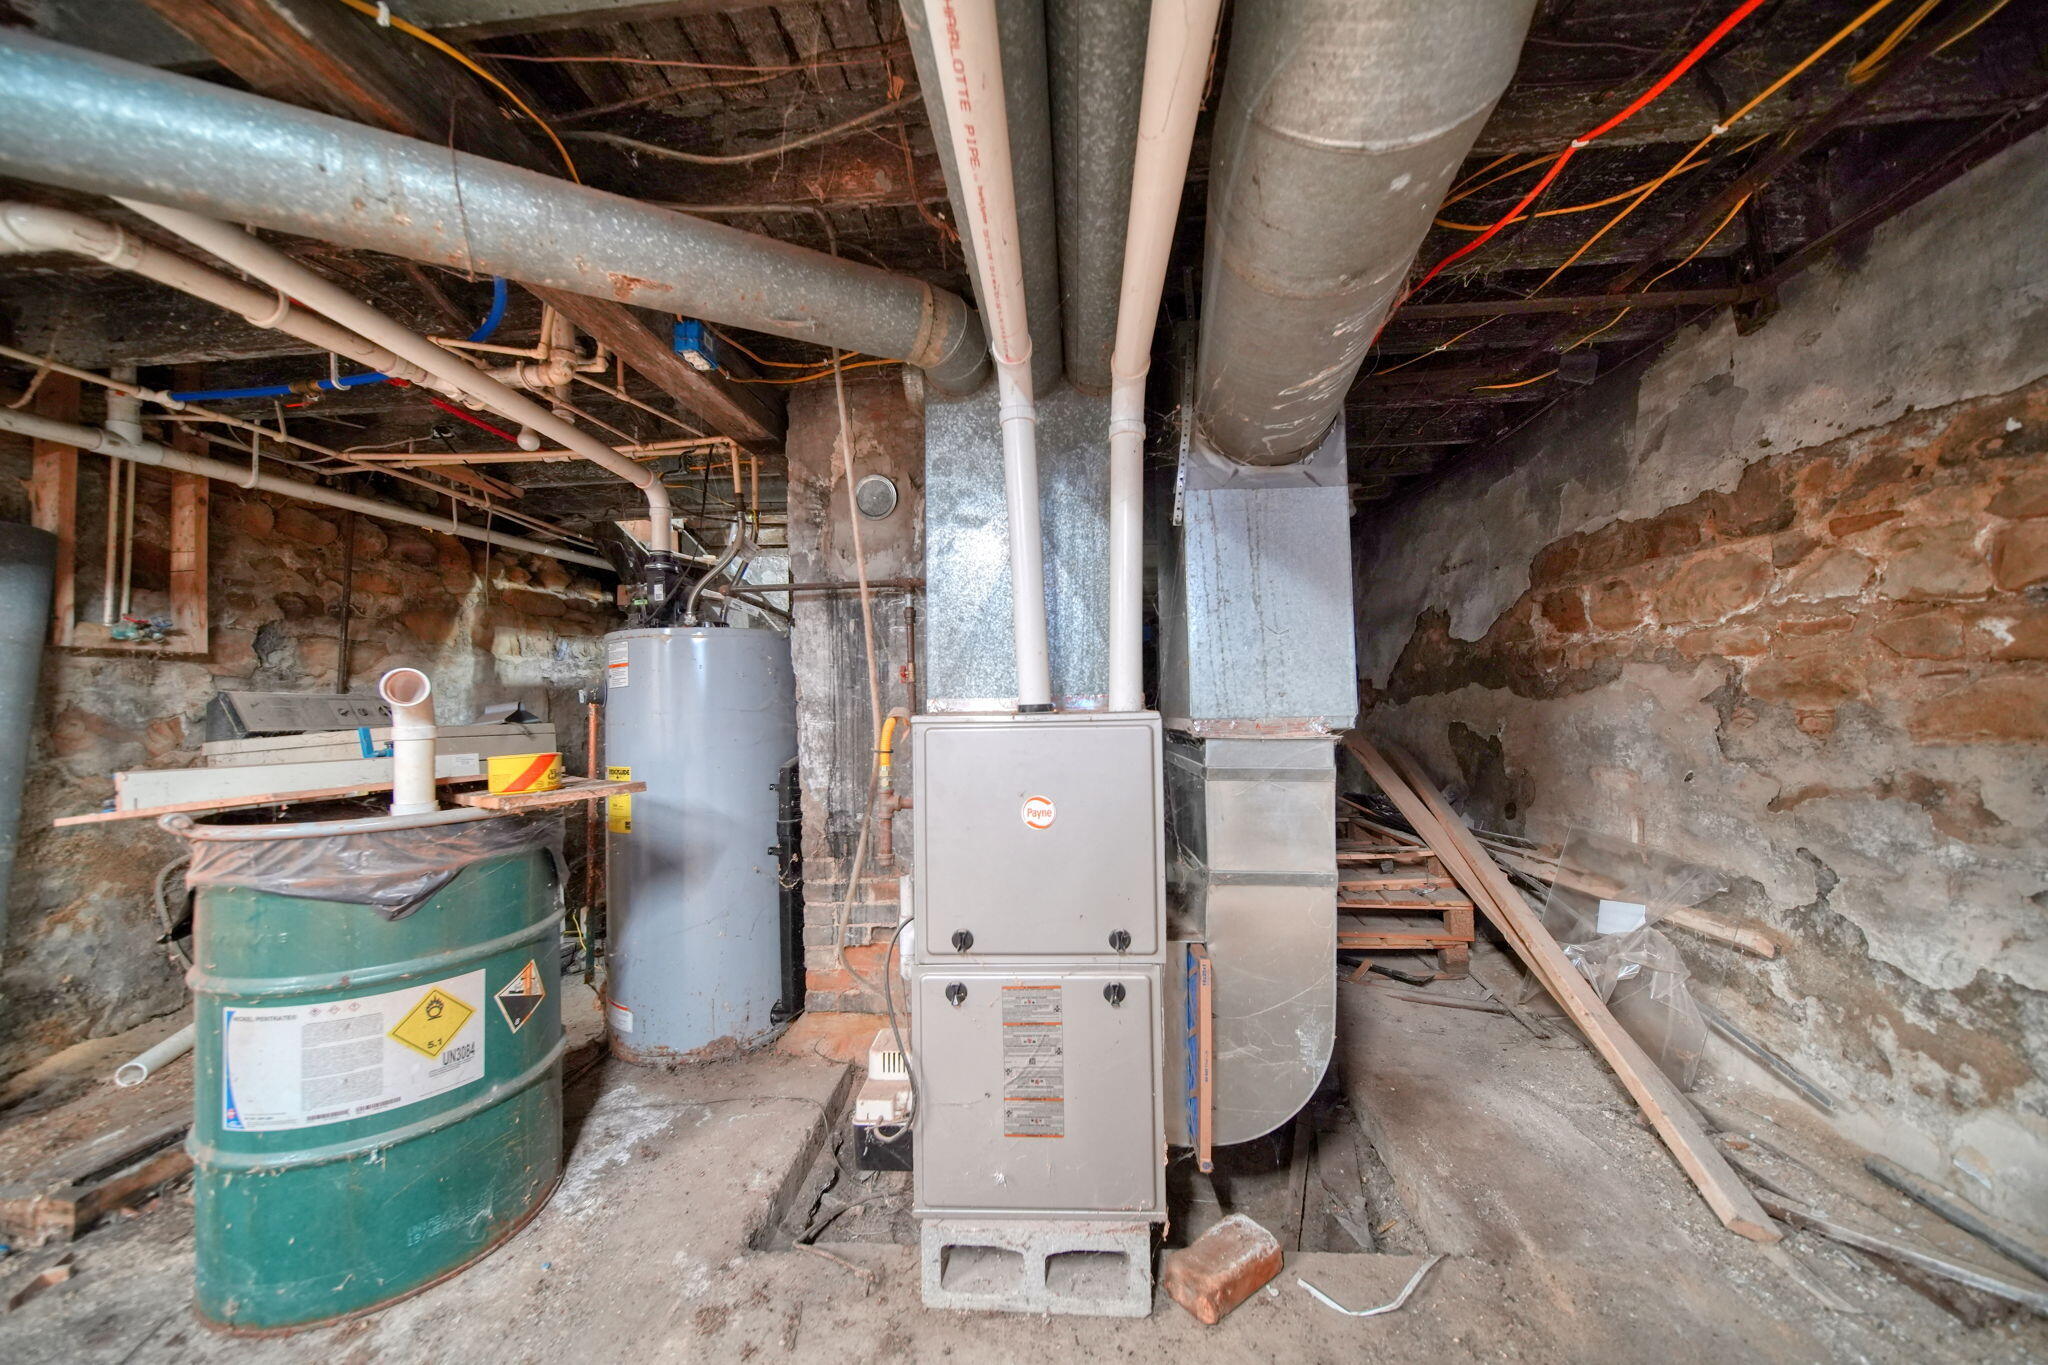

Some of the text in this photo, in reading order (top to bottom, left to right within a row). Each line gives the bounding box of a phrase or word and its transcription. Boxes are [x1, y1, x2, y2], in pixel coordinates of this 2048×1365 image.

[944, 0, 981, 170] HARLOTTE PIPE
[1027, 808, 1052, 819] Payne
[427, 1038, 443, 1049] 5.1
[442, 1041, 476, 1066] UN3084
